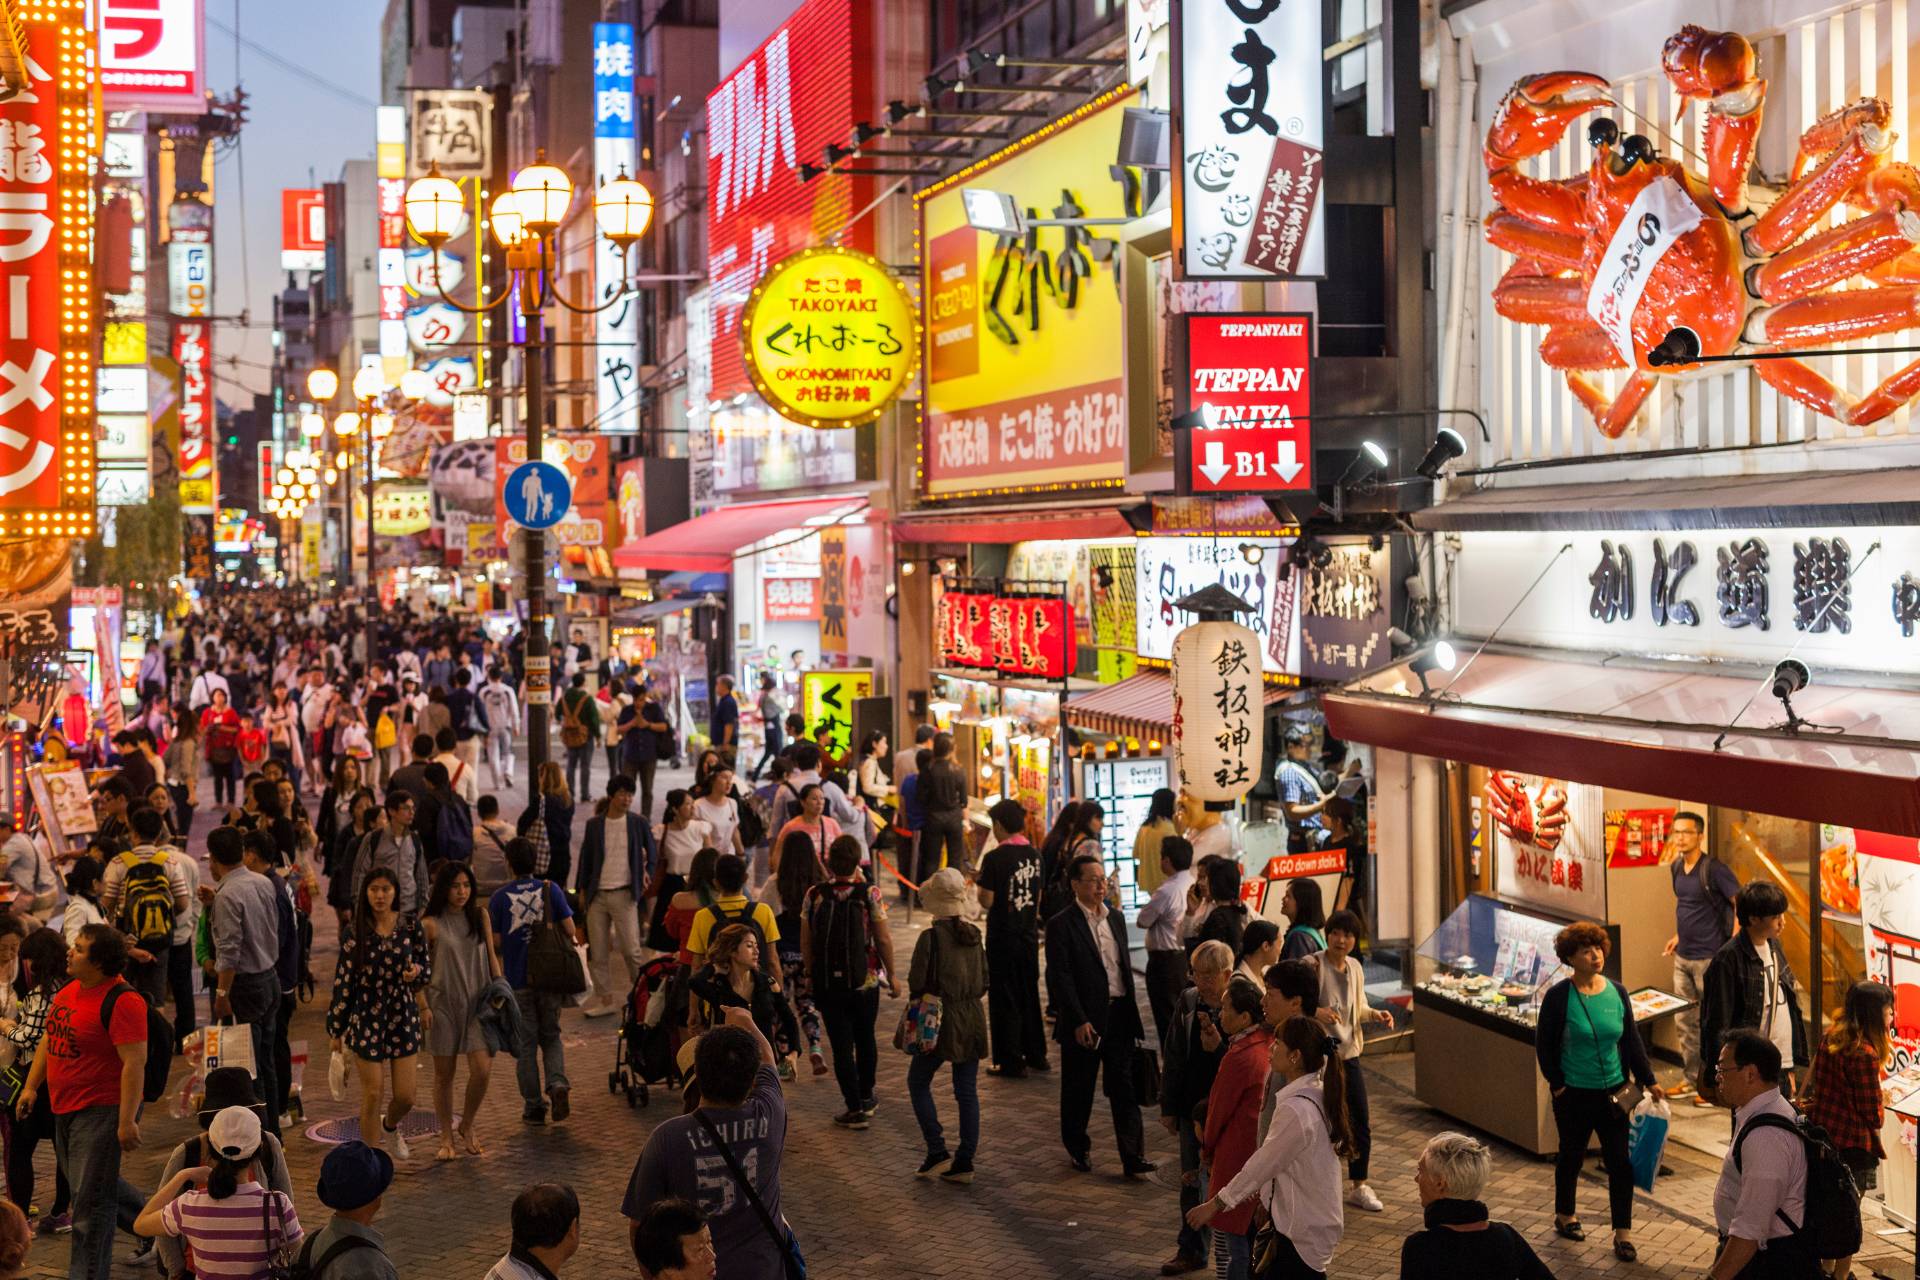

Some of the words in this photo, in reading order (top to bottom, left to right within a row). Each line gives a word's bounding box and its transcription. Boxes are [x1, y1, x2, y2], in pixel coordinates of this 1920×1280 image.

[594, 41, 634, 123] 焼肉
[0, 53, 56, 497] 龍ラーメン
[804, 278, 862, 294] たこ焼
[789, 298, 878, 312] TAKOYAKI
[766, 322, 902, 356] くれおーる
[1220, 323, 1303, 337] TEPPANYAKI
[776, 368, 892, 381] OKONOMIYAKI
[1194, 367, 1304, 393] TEPPAN
[796, 385, 870, 402] お好み焼
[1196, 404, 1295, 430] INJYA
[938, 416, 990, 468] 大阪名物
[1234, 451, 1268, 477] B1
[1212, 640, 1251, 789] 鉄板神社
[1280, 859, 1294, 874] GO
[1295, 858, 1317, 872] down
[1014, 858, 1036, 912] 神社
[695, 1146, 759, 1216] 51
